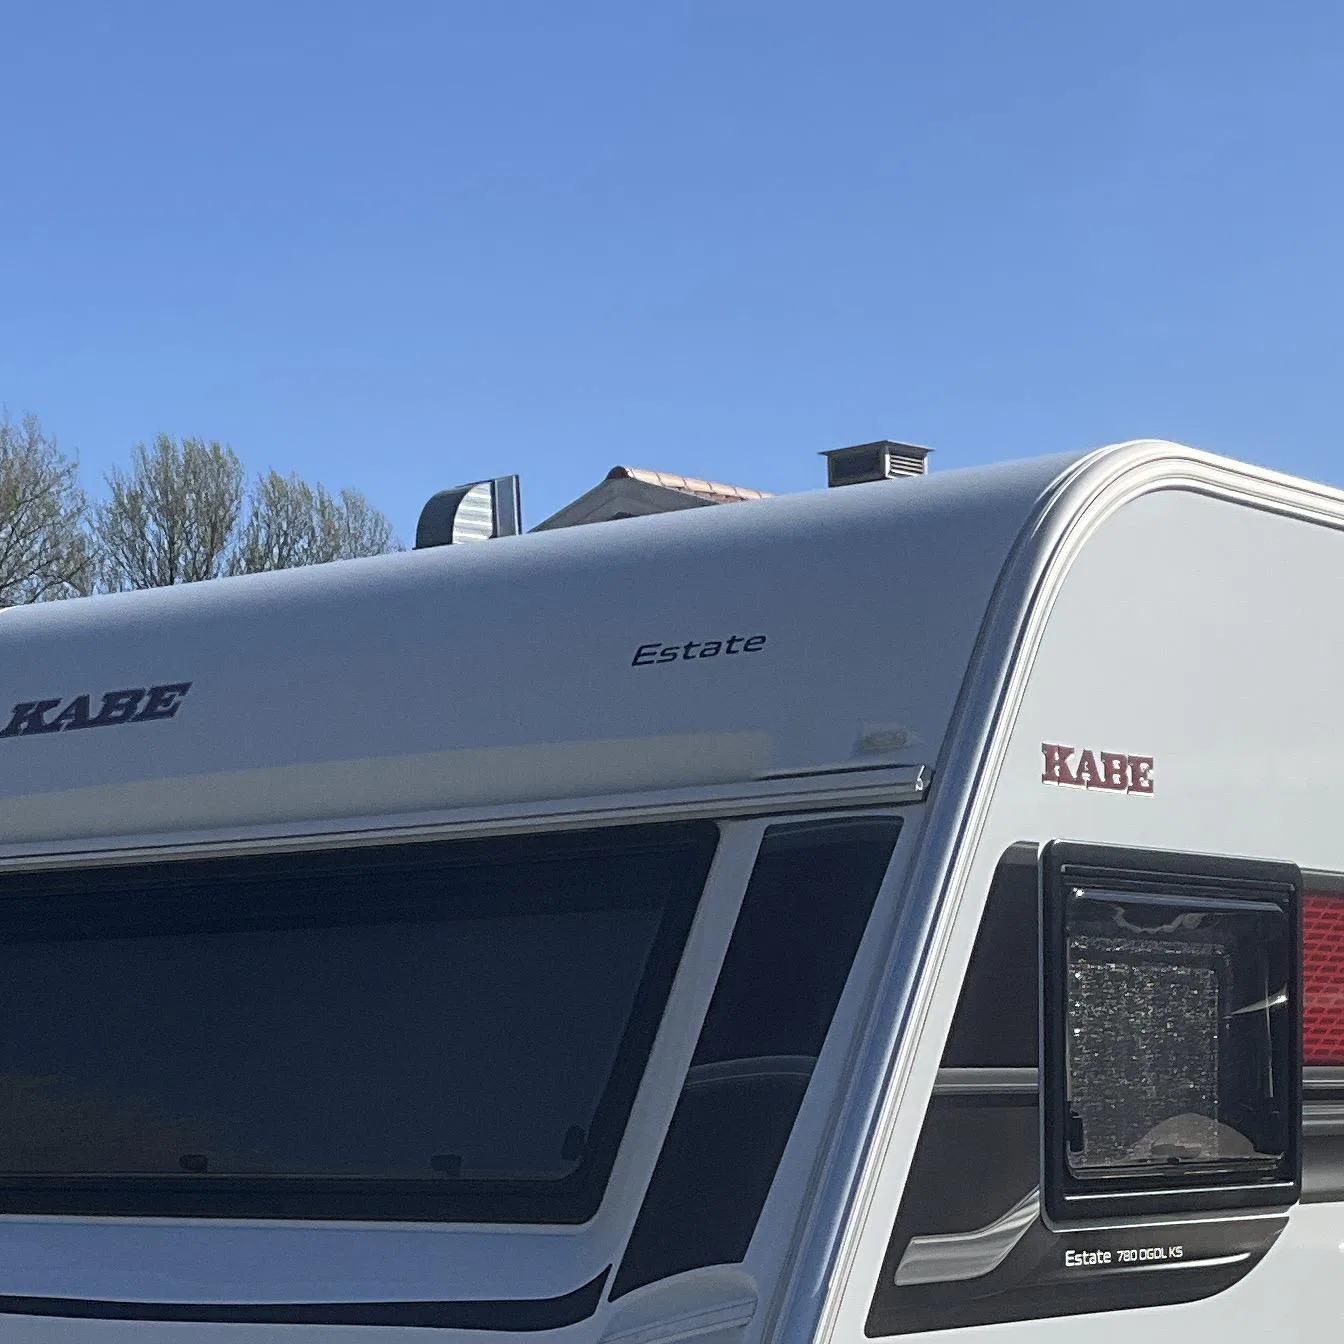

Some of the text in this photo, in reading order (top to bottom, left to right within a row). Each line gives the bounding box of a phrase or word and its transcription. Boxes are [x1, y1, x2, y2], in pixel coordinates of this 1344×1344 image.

[631, 635, 767, 667] Estate
[1041, 742, 1154, 795] KABE
[1065, 1249, 1112, 1267] Estate
[1116, 1250, 1138, 1262] 780
[1168, 1245, 1184, 1258] KS
